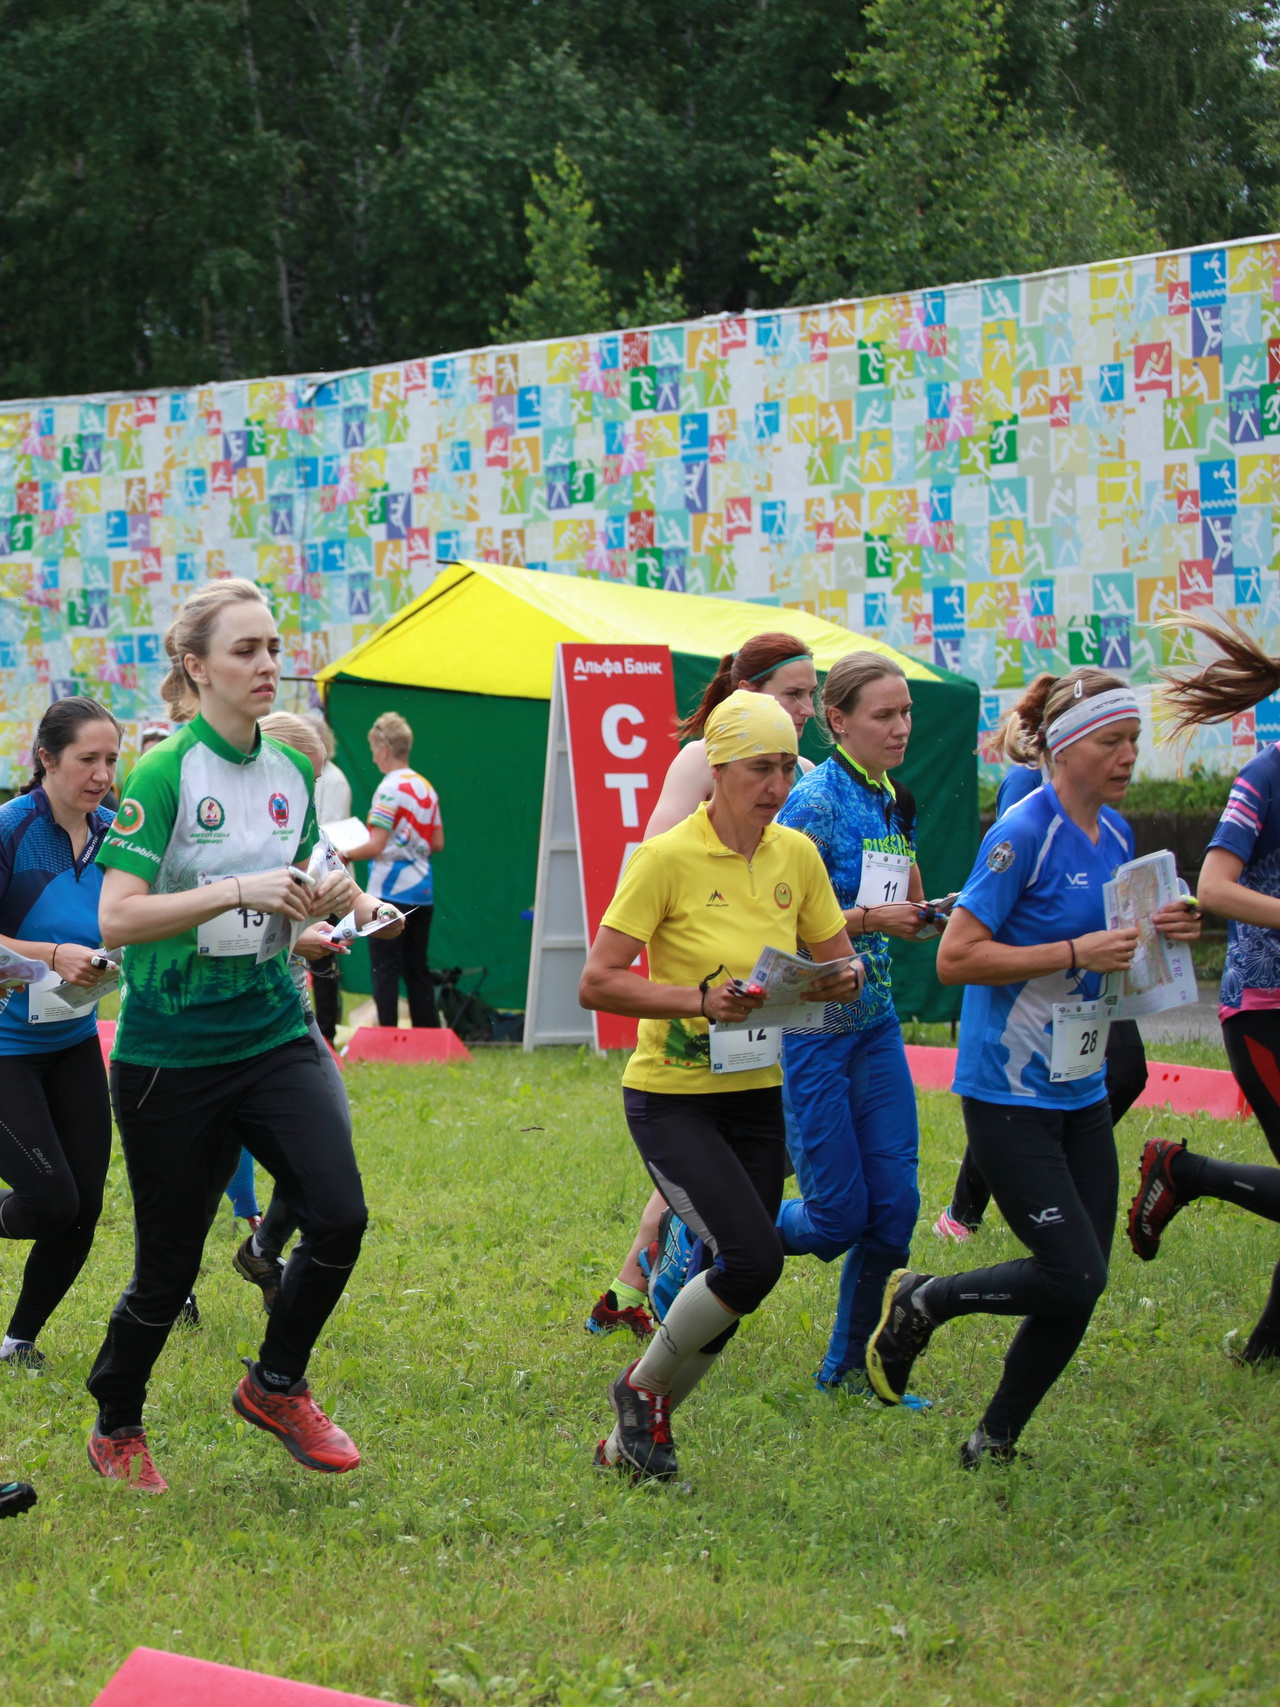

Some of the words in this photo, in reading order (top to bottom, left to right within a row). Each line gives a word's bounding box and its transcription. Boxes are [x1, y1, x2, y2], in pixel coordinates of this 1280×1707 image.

[573, 657, 624, 680] Альфа
[624, 657, 663, 675] Банк
[126, 842, 162, 864] Labirin
[1065, 873, 1088, 885] VC
[884, 880, 898, 903] 11
[1079, 1029, 1098, 1056] 28
[32, 1147, 51, 1169] CRAFT
